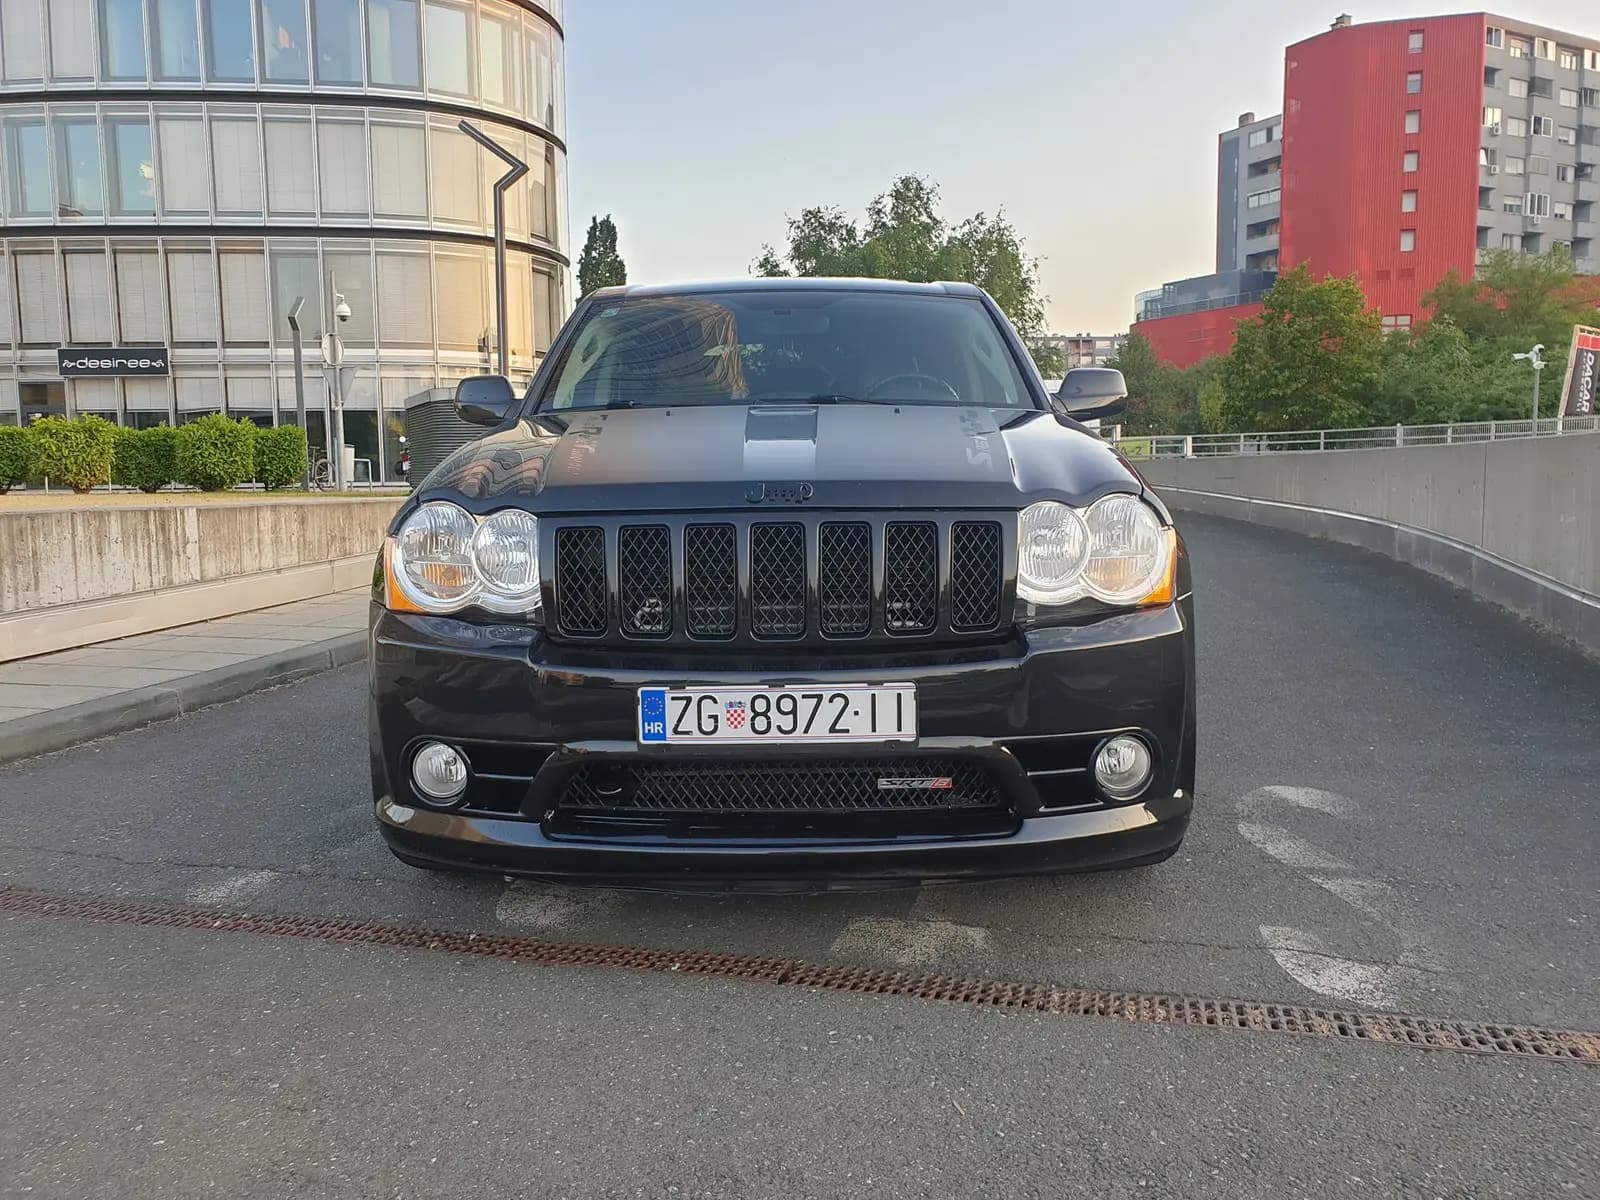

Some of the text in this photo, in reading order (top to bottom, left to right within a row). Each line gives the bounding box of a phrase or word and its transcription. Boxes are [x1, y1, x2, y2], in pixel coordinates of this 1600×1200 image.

[76, 357, 151, 369] desiree
[1581, 351, 1595, 413] DACAR
[644, 722, 664, 734] HR
[670, 694, 719, 736] ZG
